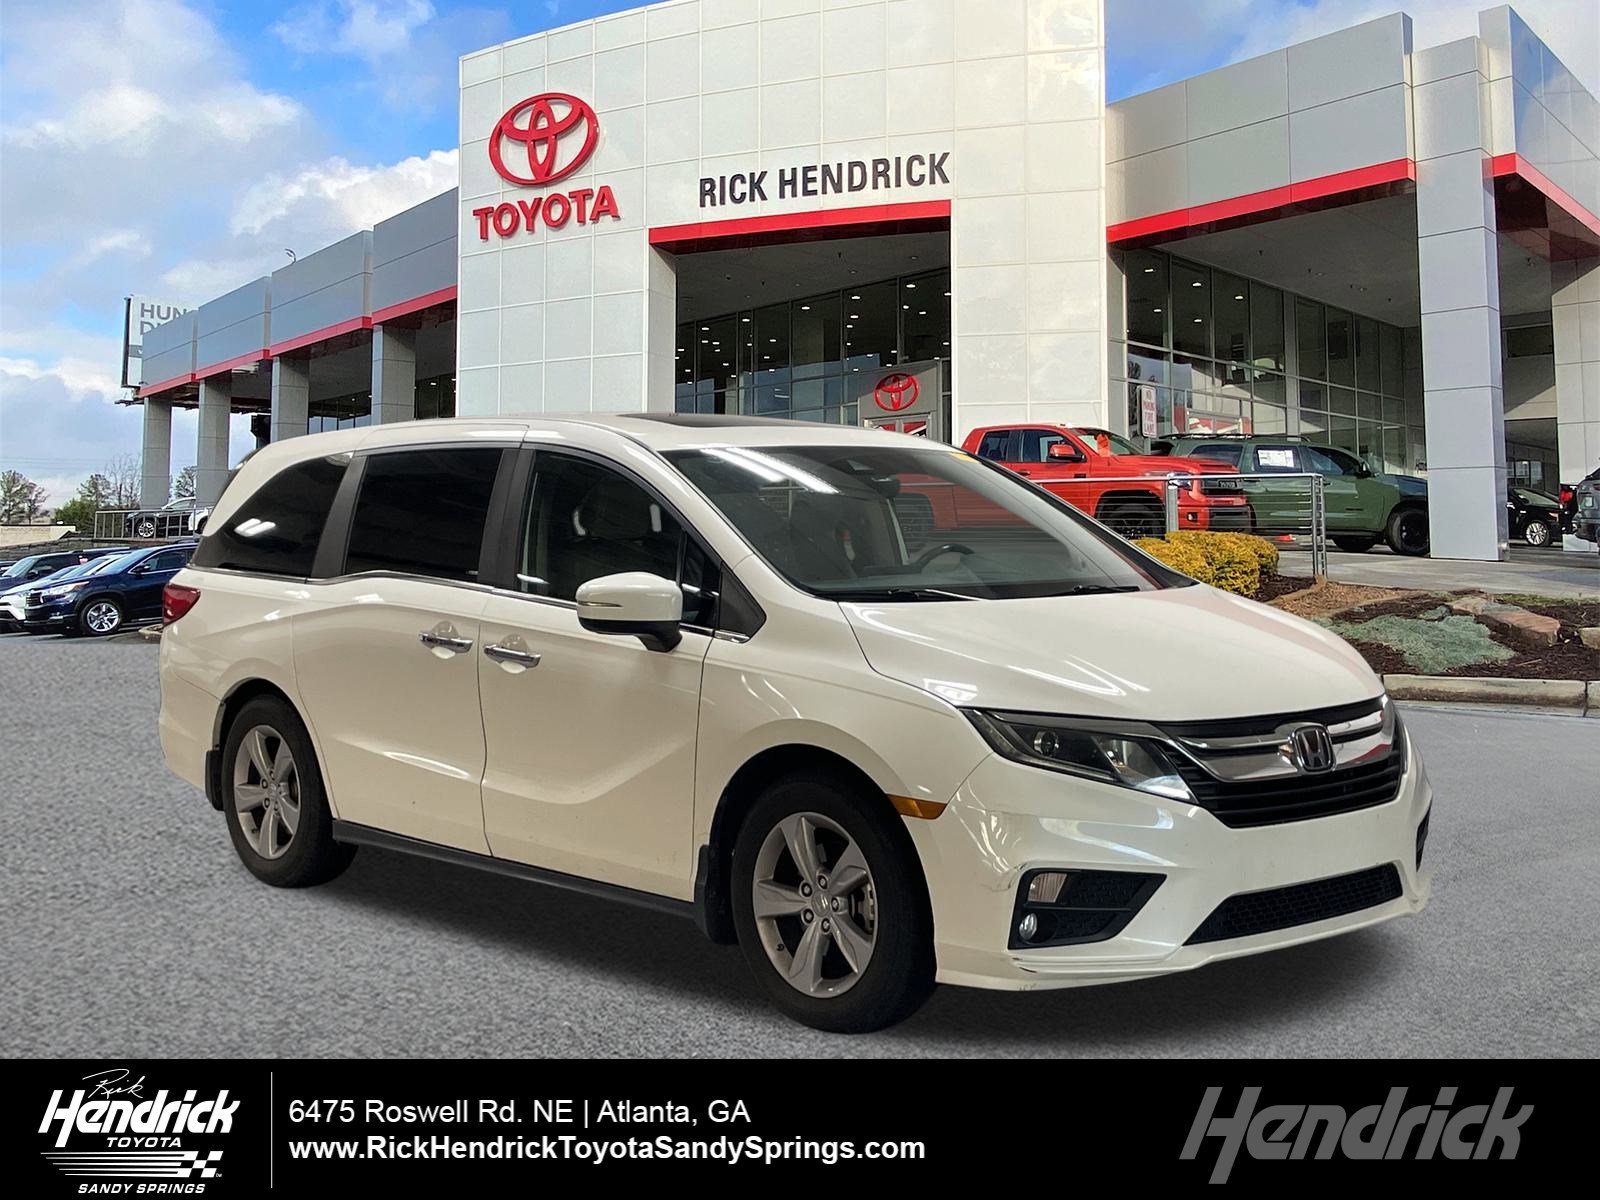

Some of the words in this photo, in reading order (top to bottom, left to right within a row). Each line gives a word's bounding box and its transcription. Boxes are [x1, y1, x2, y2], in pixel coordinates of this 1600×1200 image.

[699, 170, 768, 208] RICK
[778, 152, 950, 199] HENDRICK
[472, 184, 621, 242] TOYOTA
